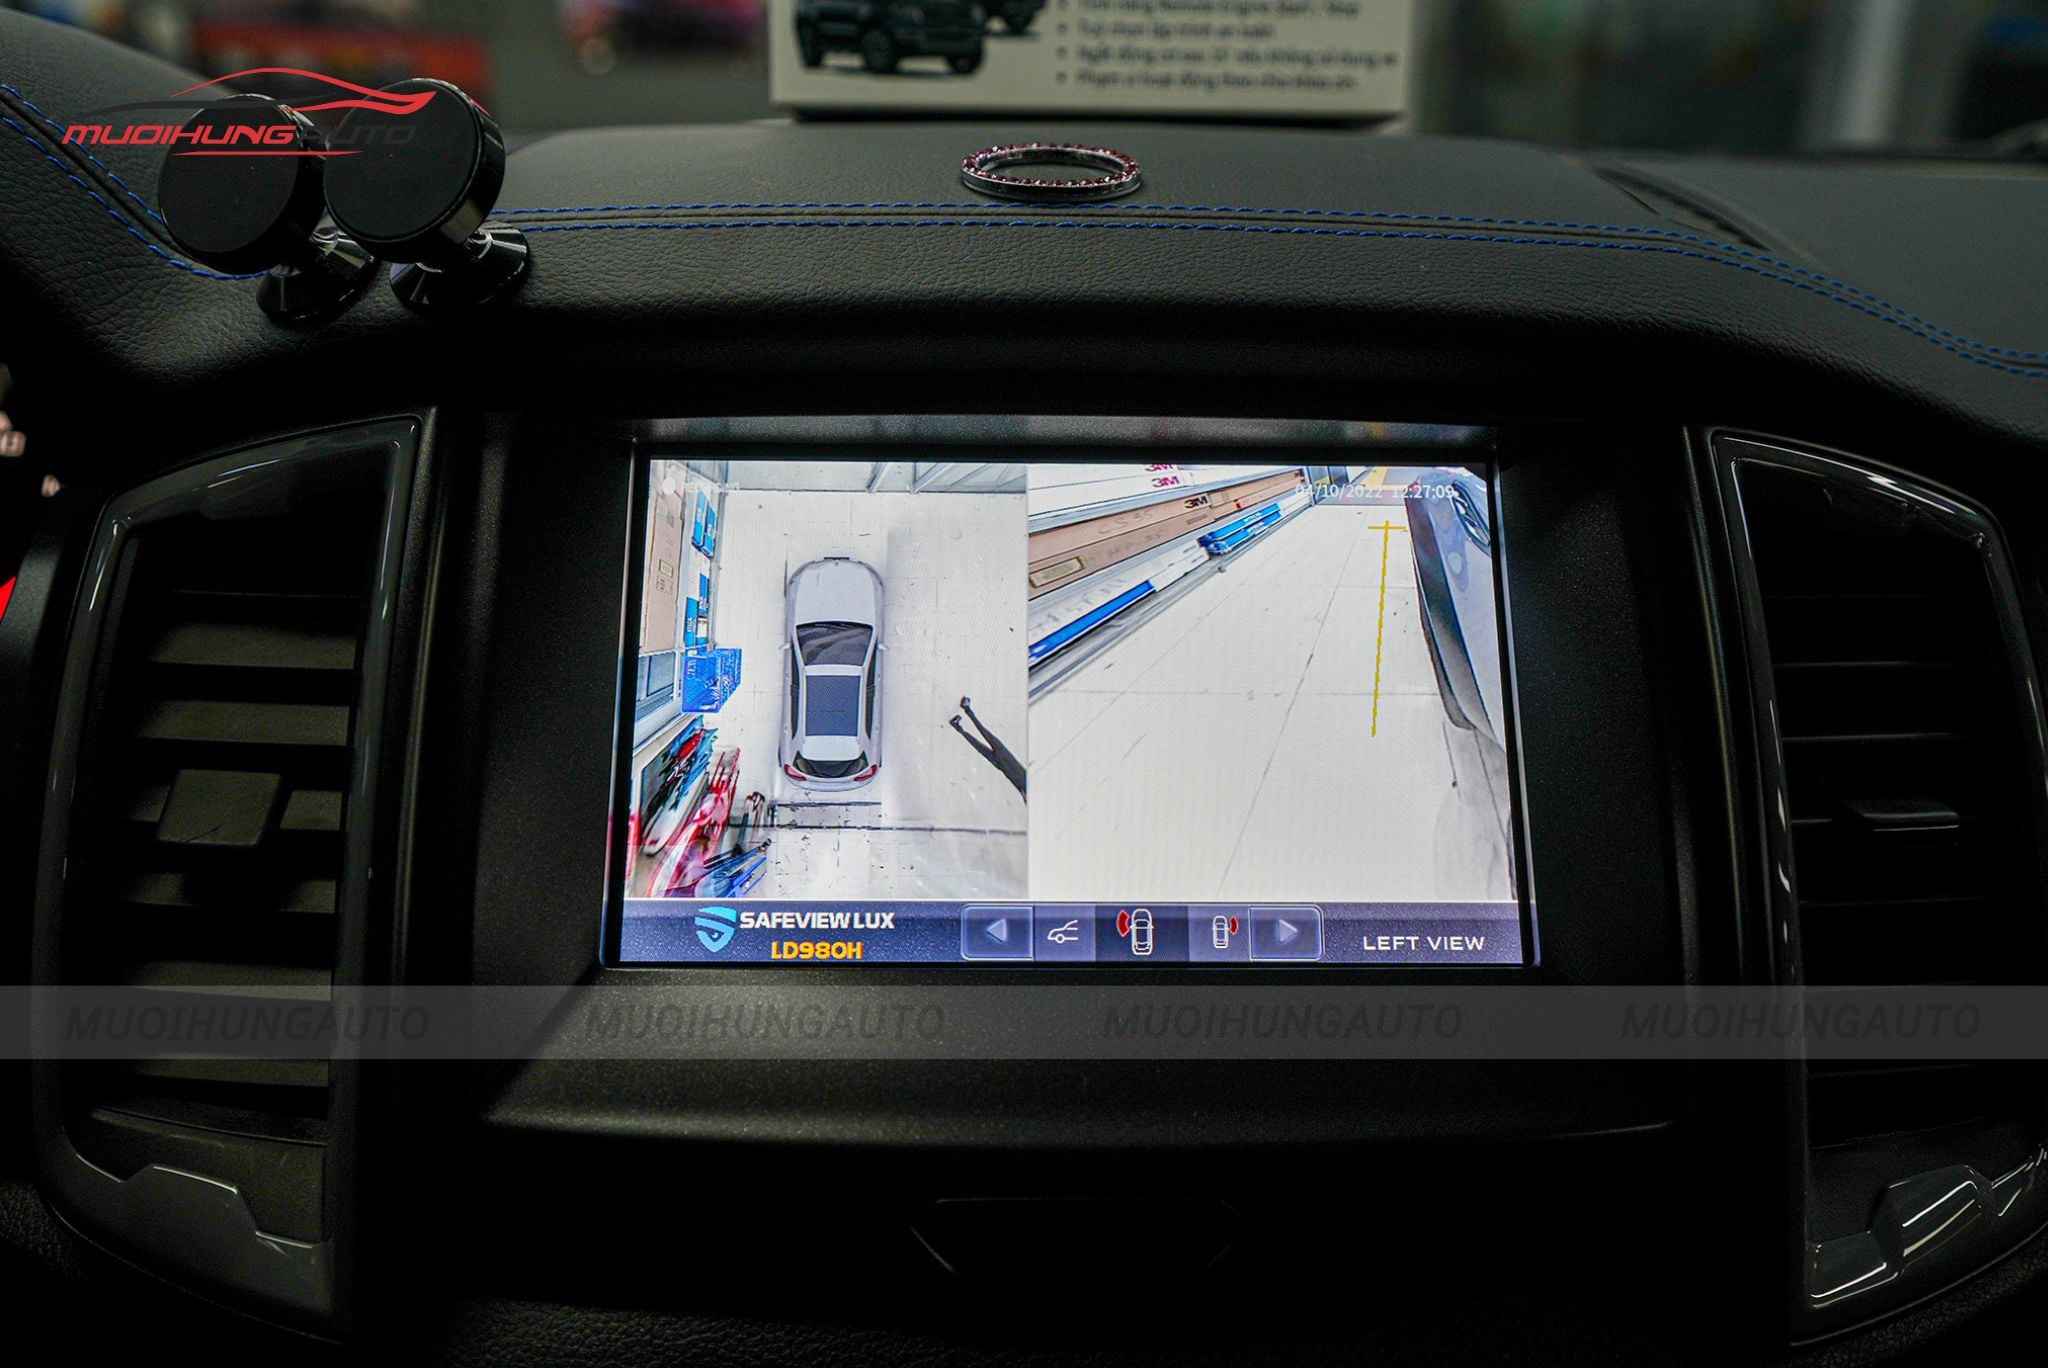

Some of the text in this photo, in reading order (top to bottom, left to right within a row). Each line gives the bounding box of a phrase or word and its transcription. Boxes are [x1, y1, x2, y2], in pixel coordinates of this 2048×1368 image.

[1151, 475, 1180, 488] 3M
[1393, 485, 1454, 499] 12:27:09
[1184, 495, 1209, 509] 3M
[739, 911, 896, 929] SAFEVIEW LUX
[1363, 936, 1485, 951] LEFT VIEW
